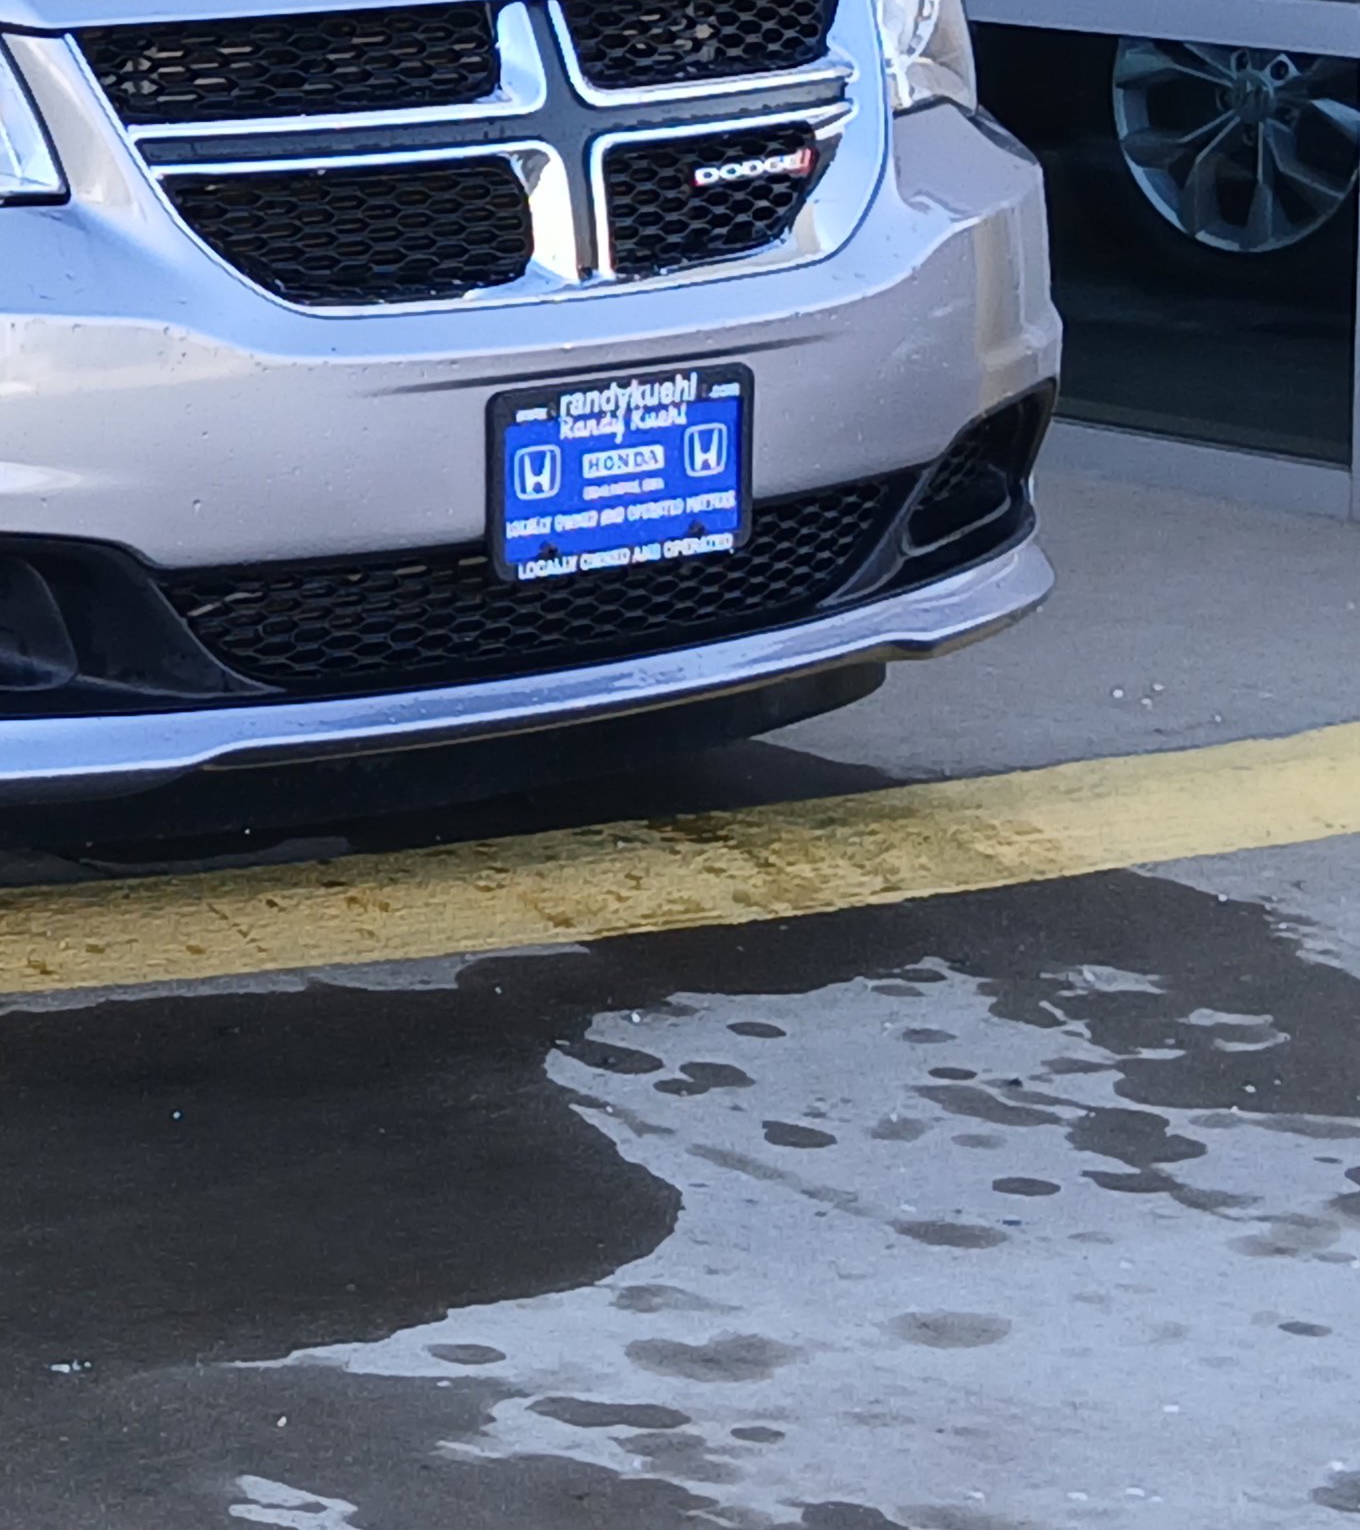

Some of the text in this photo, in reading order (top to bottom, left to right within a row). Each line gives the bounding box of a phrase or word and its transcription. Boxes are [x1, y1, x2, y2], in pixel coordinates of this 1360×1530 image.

[695, 155, 800, 186] DODGE
[560, 412, 624, 444] Randy
[631, 404, 687, 430] Kuehl
[588, 449, 659, 471] HONDA
[518, 555, 578, 580] LOCALLY
